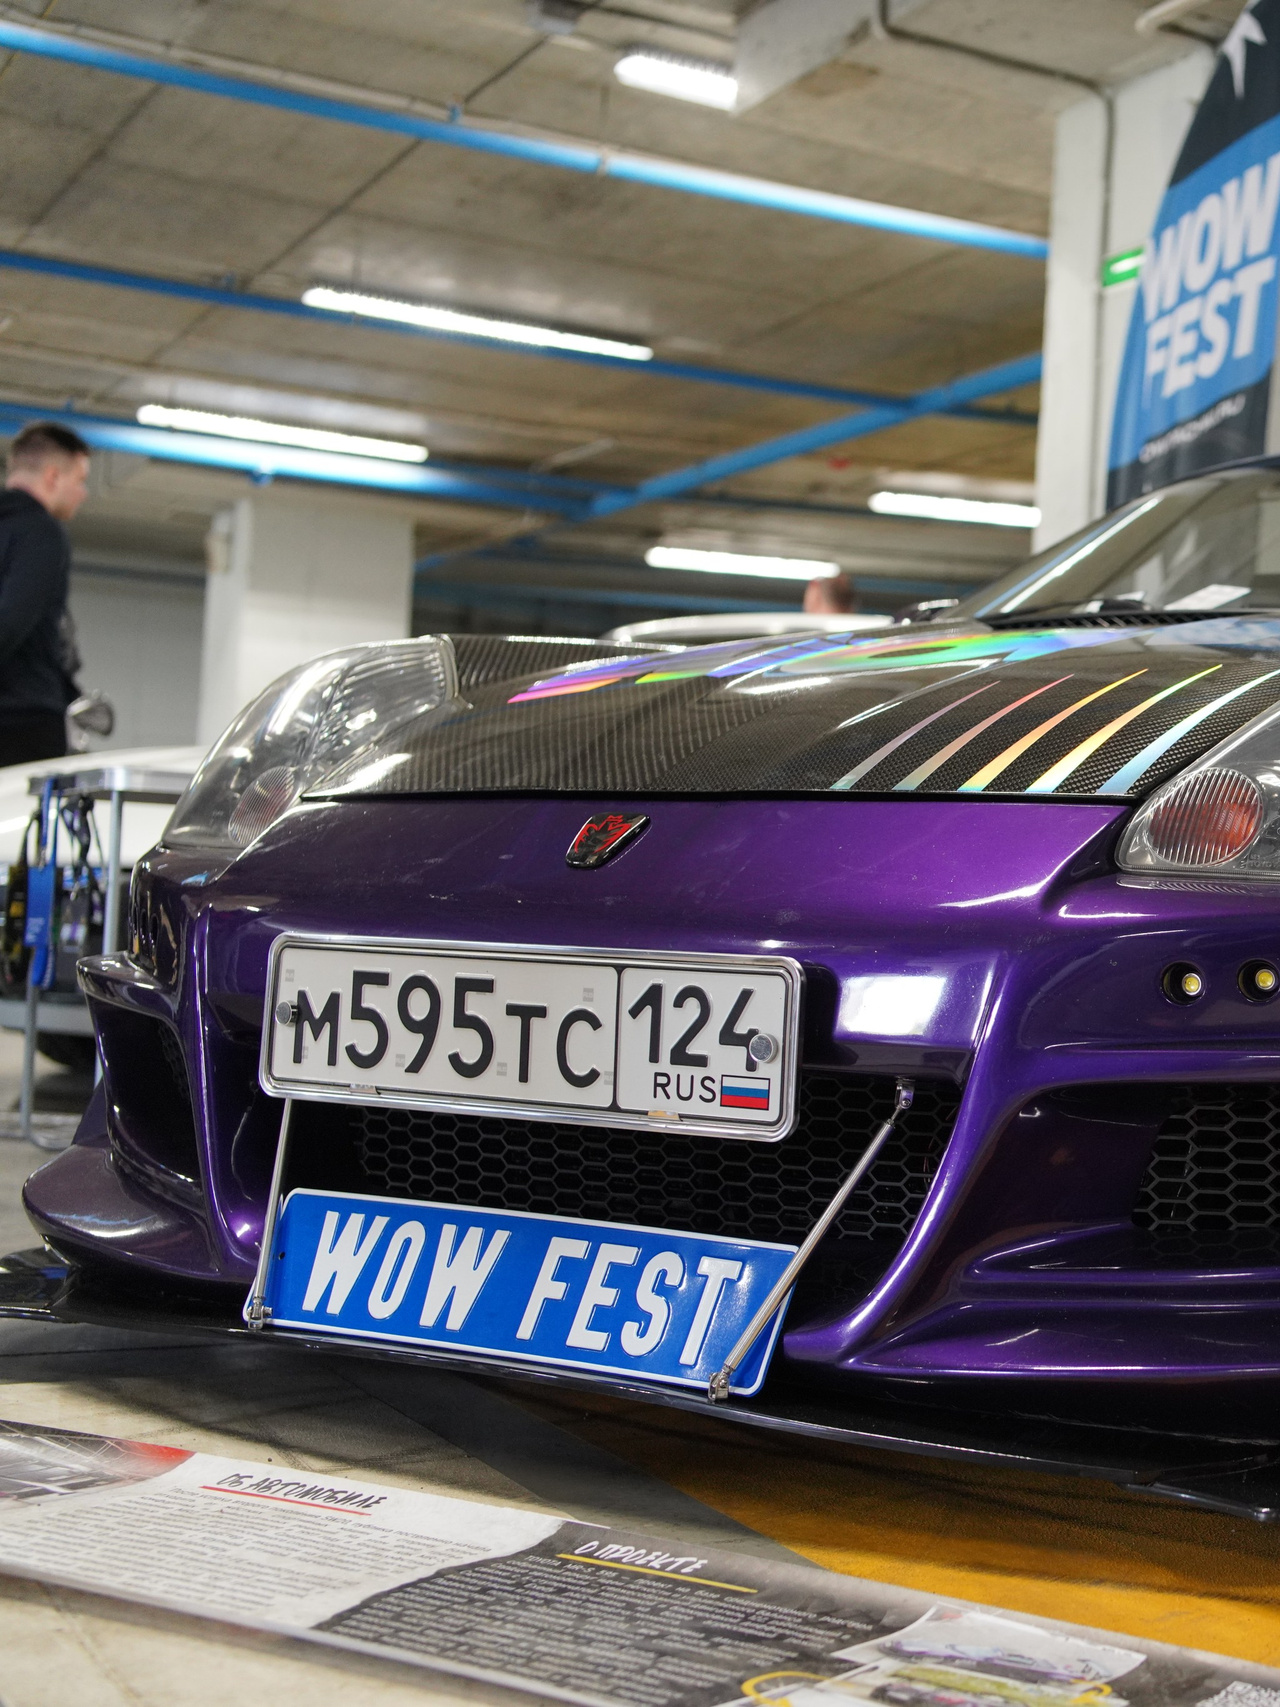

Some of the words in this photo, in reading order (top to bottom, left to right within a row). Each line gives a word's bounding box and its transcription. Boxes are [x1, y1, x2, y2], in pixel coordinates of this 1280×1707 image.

[1143, 256, 1277, 405] FEST
[627, 982, 761, 1073] 124
[652, 1071, 717, 1104] RUS
[301, 1210, 512, 1331] WOW
[515, 1236, 743, 1367] FEST
[216, 1473, 253, 1487] ОБ
[251, 1478, 388, 1509] АВТОМОБИЛЕ
[574, 1540, 599, 1555] О
[593, 1544, 709, 1574] ПРОЕКТЕ
